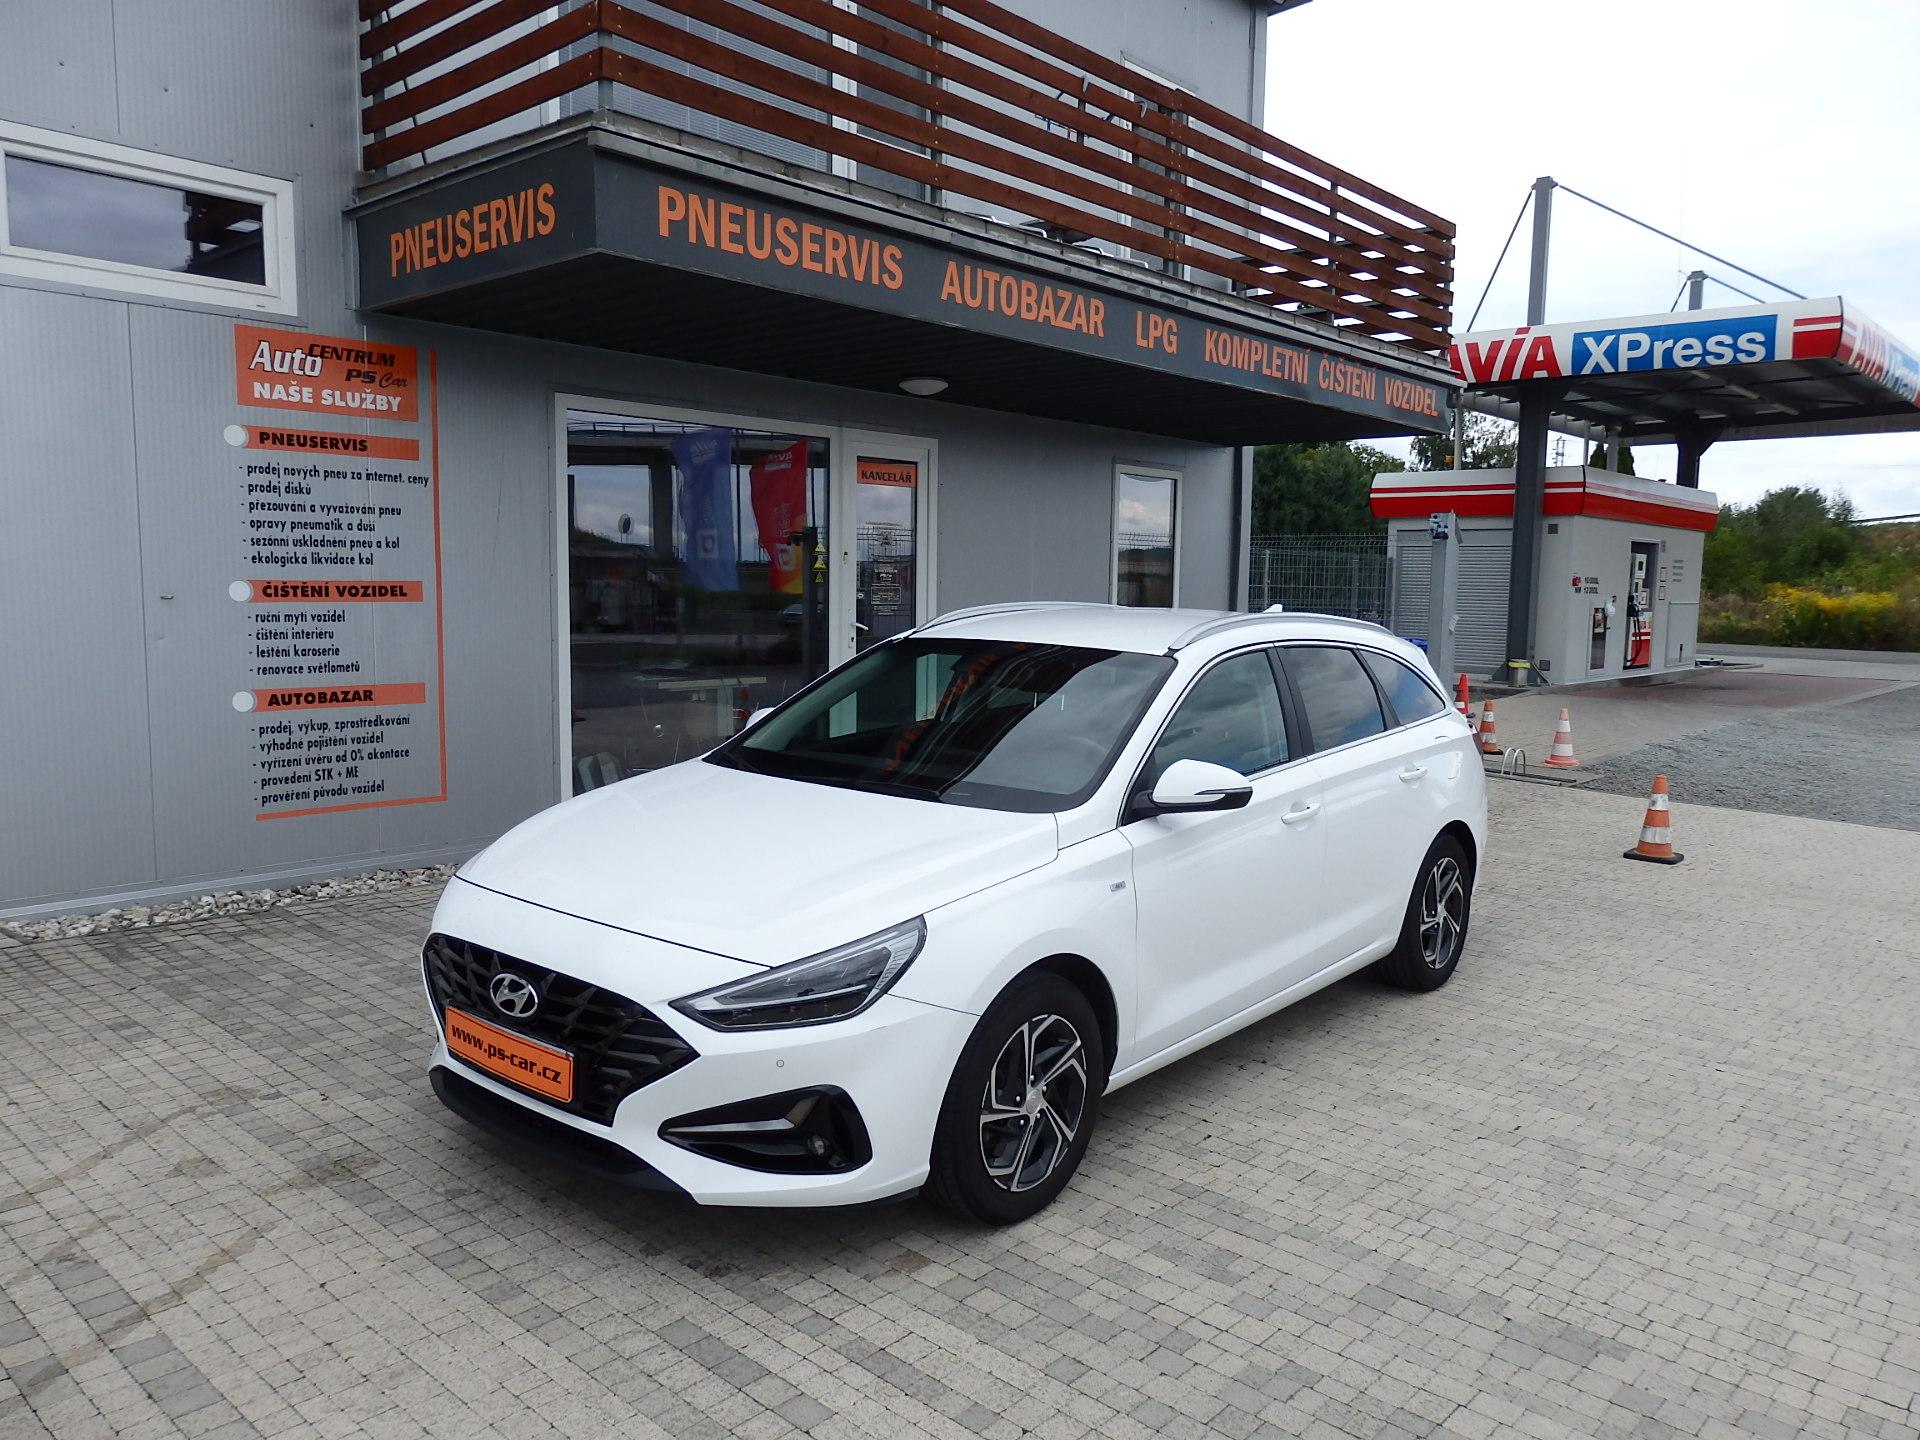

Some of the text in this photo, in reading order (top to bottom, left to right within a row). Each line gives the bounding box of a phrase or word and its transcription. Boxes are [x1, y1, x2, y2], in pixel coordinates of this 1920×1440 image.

[390, 183, 556, 278] PNEUSERVIS
[658, 185, 1438, 417] PNEUSERVIS AUTOBAZAR LPG KOMPLETNÍ ČIŠTĚNÍ VOZIDEL
[249, 340, 396, 377] Auto CENTRUM
[1580, 330, 1767, 376] XPress
[345, 369, 408, 388] PS Car
[253, 380, 402, 411] NAŠE SLUŽBY
[259, 431, 368, 451] PNEUSERVIS
[247, 462, 281, 478] prodej
[284, 465, 320, 480] nových
[324, 468, 348, 482] pneu
[351, 471, 362, 480] za
[408, 475, 429, 487] ceny
[861, 469, 912, 484] KANCELÁŘ
[248, 481, 311, 497] prodej disků
[310, 504, 316, 513] a
[379, 506, 402, 518] pneu
[250, 520, 286, 532] opravy
[291, 518, 343, 532] pneumatik
[347, 522, 353, 531] a
[350, 538, 373, 551] pneu
[376, 540, 382, 549] a
[385, 536, 400, 549] kol
[252, 551, 374, 568] ekologická likvidace kol
[262, 581, 407, 598] ČIŠTĚNÍ VOZIDEL
[255, 612, 281, 623] ruční
[311, 610, 346, 623] vozidel
[292, 627, 334, 640] interiéru
[294, 644, 340, 657] karoserie
[257, 665, 304, 675] renovace
[268, 690, 374, 707] AUTOBAZAR
[298, 719, 331, 735] výkup,
[260, 738, 304, 755] výhodné
[351, 731, 384, 745] vozidel
[336, 750, 347, 763] od
[351, 749, 364, 761] 0%
[367, 748, 410, 760] akontace
[261, 771, 312, 790] provedení
[315, 768, 334, 782] STK
[346, 766, 359, 779] ME
[313, 784, 348, 801] původu
[351, 780, 384, 795] vozidel
[452, 1025, 562, 1084] www.ps-car.cz
